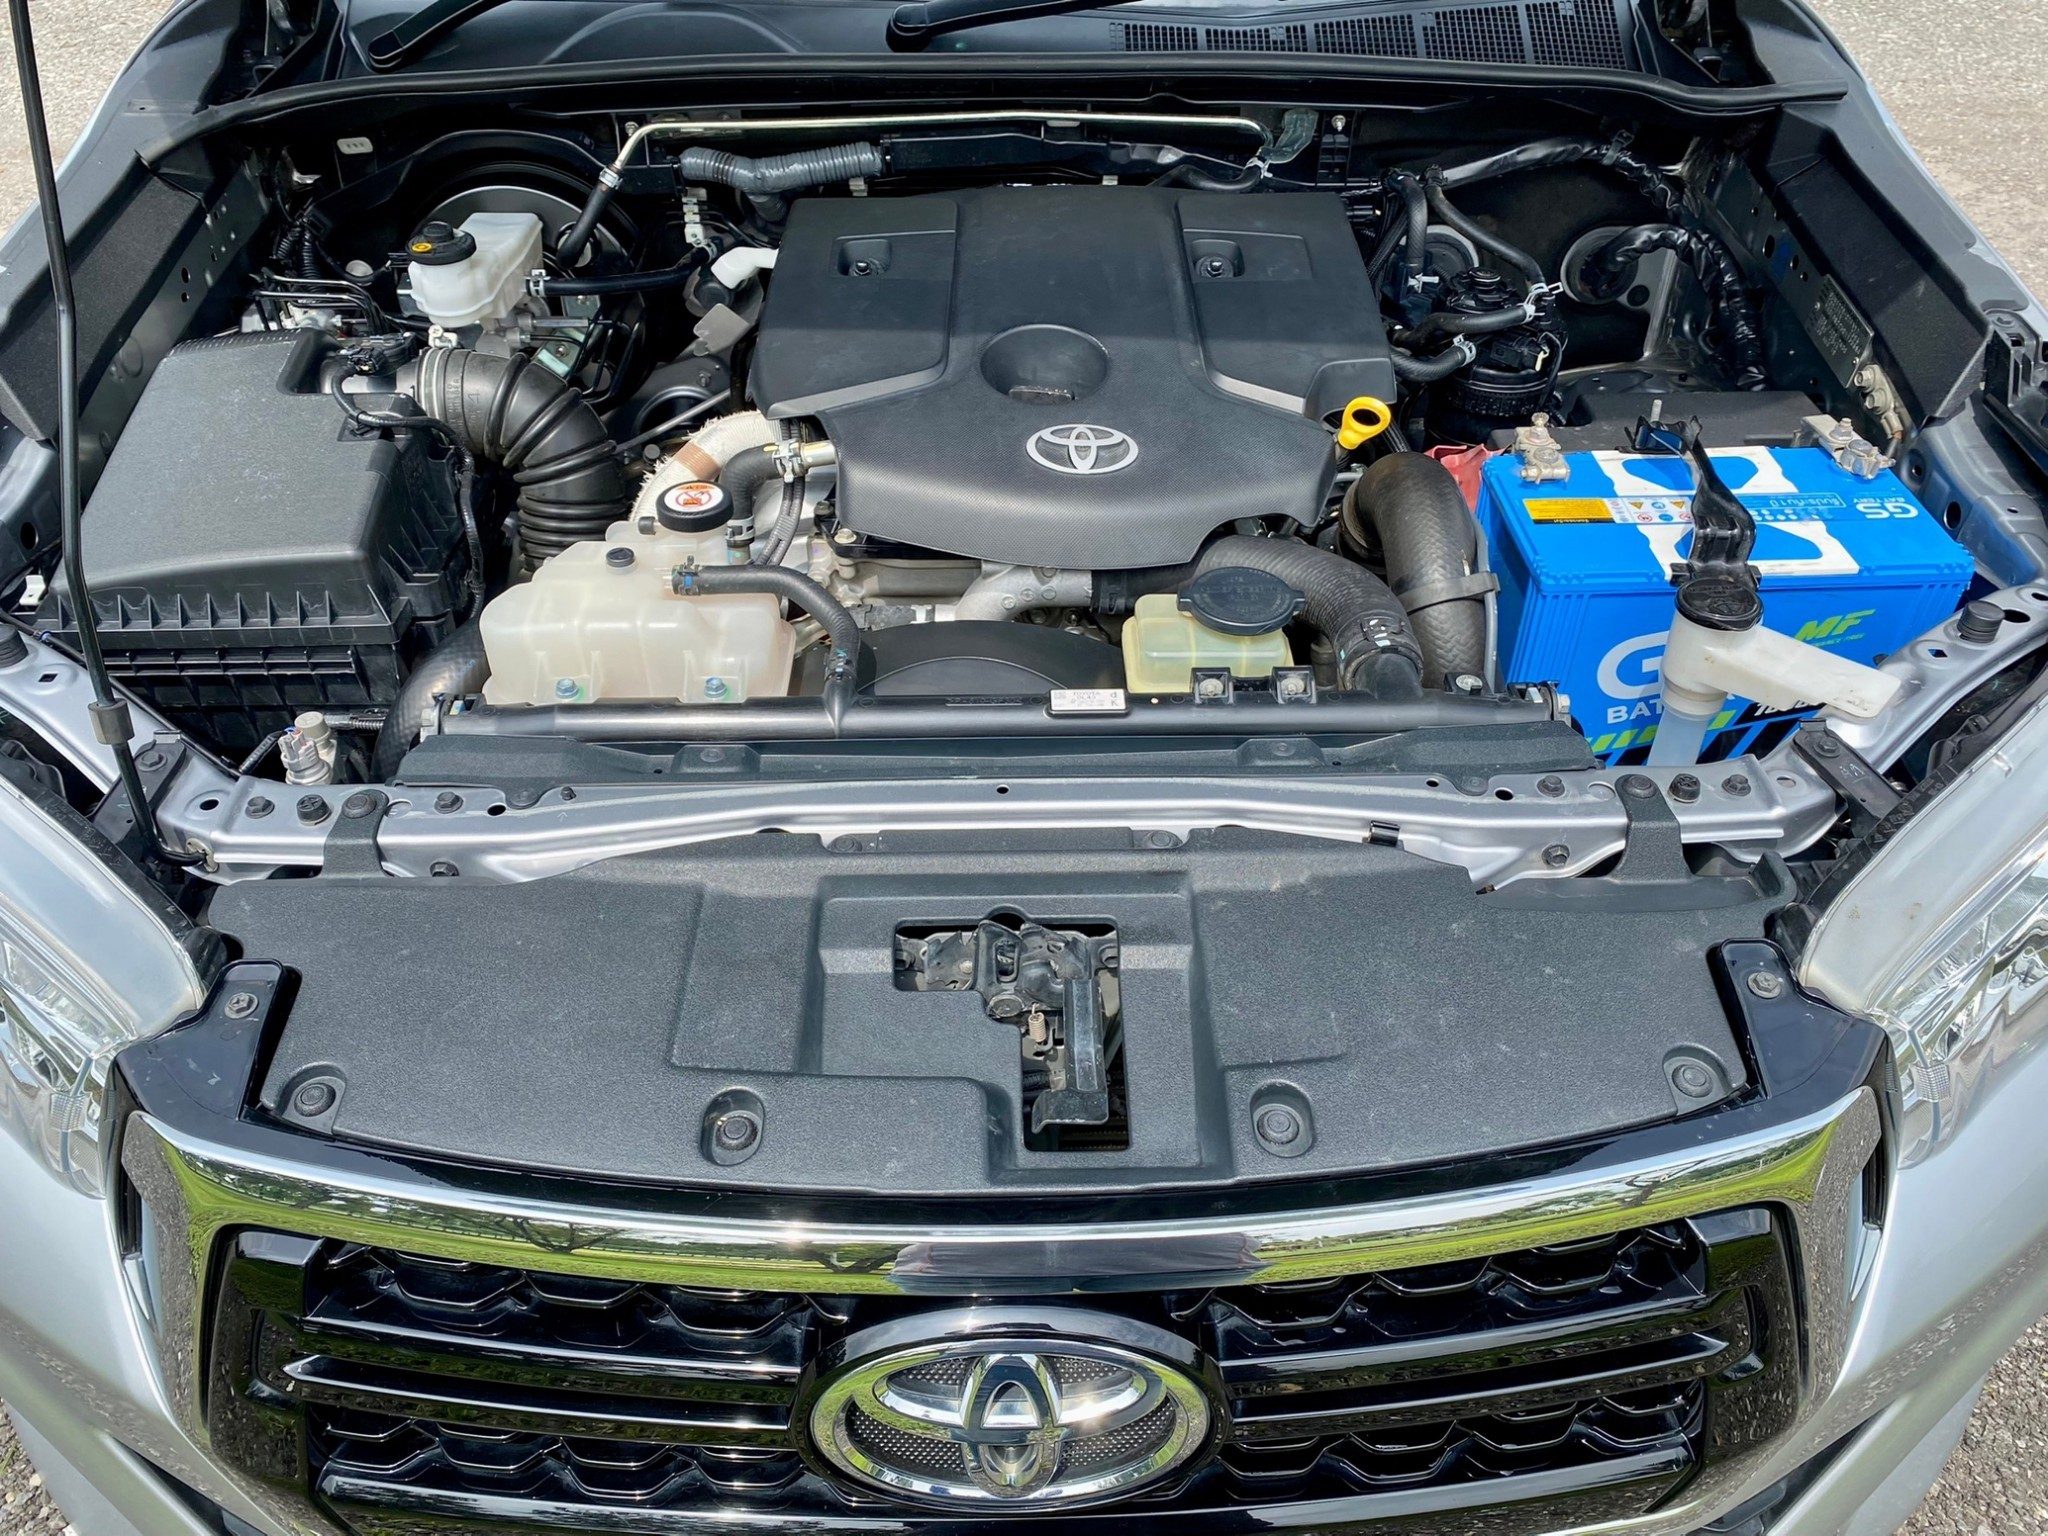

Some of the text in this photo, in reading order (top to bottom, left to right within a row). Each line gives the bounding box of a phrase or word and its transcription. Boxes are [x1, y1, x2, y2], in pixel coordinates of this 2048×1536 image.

[1856, 502, 1919, 519] GS
[1794, 608, 1877, 641] MF
[1597, 630, 1669, 700] G
